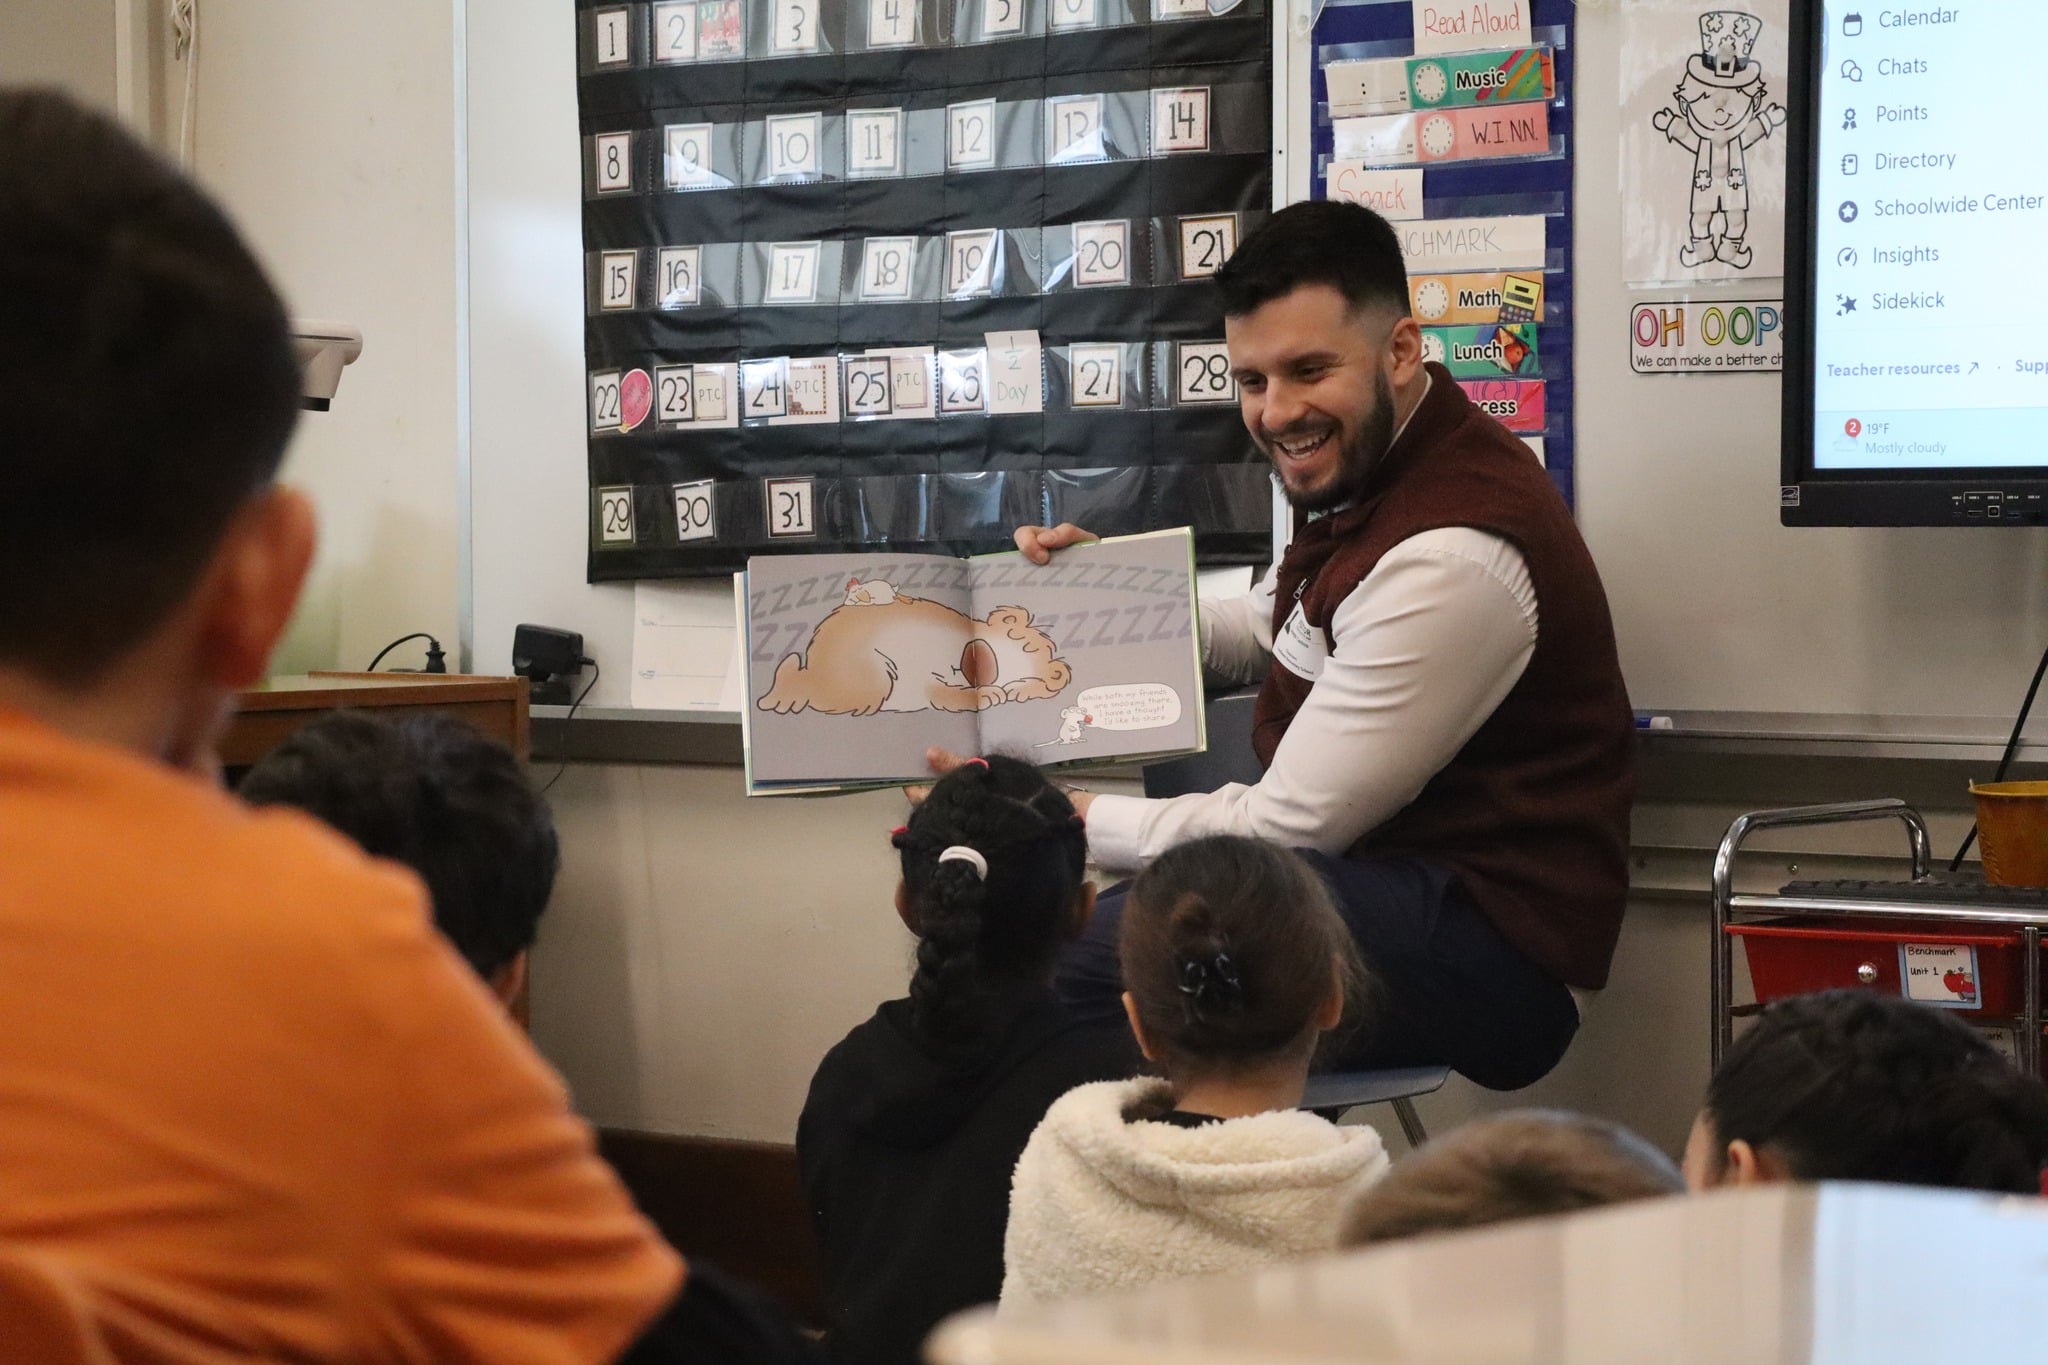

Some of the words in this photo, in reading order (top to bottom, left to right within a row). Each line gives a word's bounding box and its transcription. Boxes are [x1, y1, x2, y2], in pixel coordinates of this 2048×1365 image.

[667, 14, 686, 50] 2
[790, 6, 806, 43] 3
[1423, 8, 1467, 38] Read
[1471, 4, 1521, 35] Aloud
[1878, 7, 1960, 28] Calendar
[609, 22, 616, 57] 1
[1455, 68, 1507, 90] Music
[1877, 58, 1928, 76] Chats
[1168, 100, 1196, 141] 14
[1876, 105, 1929, 123] Points
[776, 131, 809, 168] 10
[864, 123, 883, 161] 11
[957, 115, 985, 155] 12
[606, 144, 621, 181] 8
[680, 138, 700, 174] 9
[1874, 151, 1957, 171] Directory
[1874, 196, 1979, 218] Schoolwide
[1983, 193, 2045, 212] Center
[957, 244, 984, 284] 19
[1085, 239, 1122, 273] 20
[1191, 228, 1227, 269] 21
[1872, 246, 1940, 267] Insights
[609, 265, 629, 301] 15
[666, 259, 690, 297] 16
[781, 254, 806, 291] 17
[873, 248, 902, 287] 18
[1458, 288, 1502, 308] Math
[1871, 292, 1946, 311] Sidekick
[1633, 307, 1685, 348] OH
[1700, 306, 1783, 347] OOP
[1454, 341, 1502, 361] Lunch
[1636, 354, 1653, 367] We
[1656, 355, 1677, 367] can
[1680, 353, 1711, 367] make
[1715, 356, 1723, 366] a
[1726, 352, 1768, 367] better
[1826, 362, 1885, 377] Teacher
[1887, 361, 1961, 377] resources
[850, 370, 886, 407] 25
[1079, 358, 1115, 396] 27
[1183, 353, 1229, 393] 28
[595, 383, 620, 420] 22
[661, 376, 690, 412] 23
[996, 380, 1029, 408] Day
[1848, 421, 1857, 434] 2
[1865, 422, 1890, 435] 19°F
[1864, 441, 1904, 457] Mostly
[1907, 440, 1947, 457] cloudy
[602, 497, 631, 534] 29
[677, 496, 711, 533] 30
[778, 491, 805, 528] 31
[1910, 967, 1929, 976] Unit
[1933, 966, 1940, 976] 1
